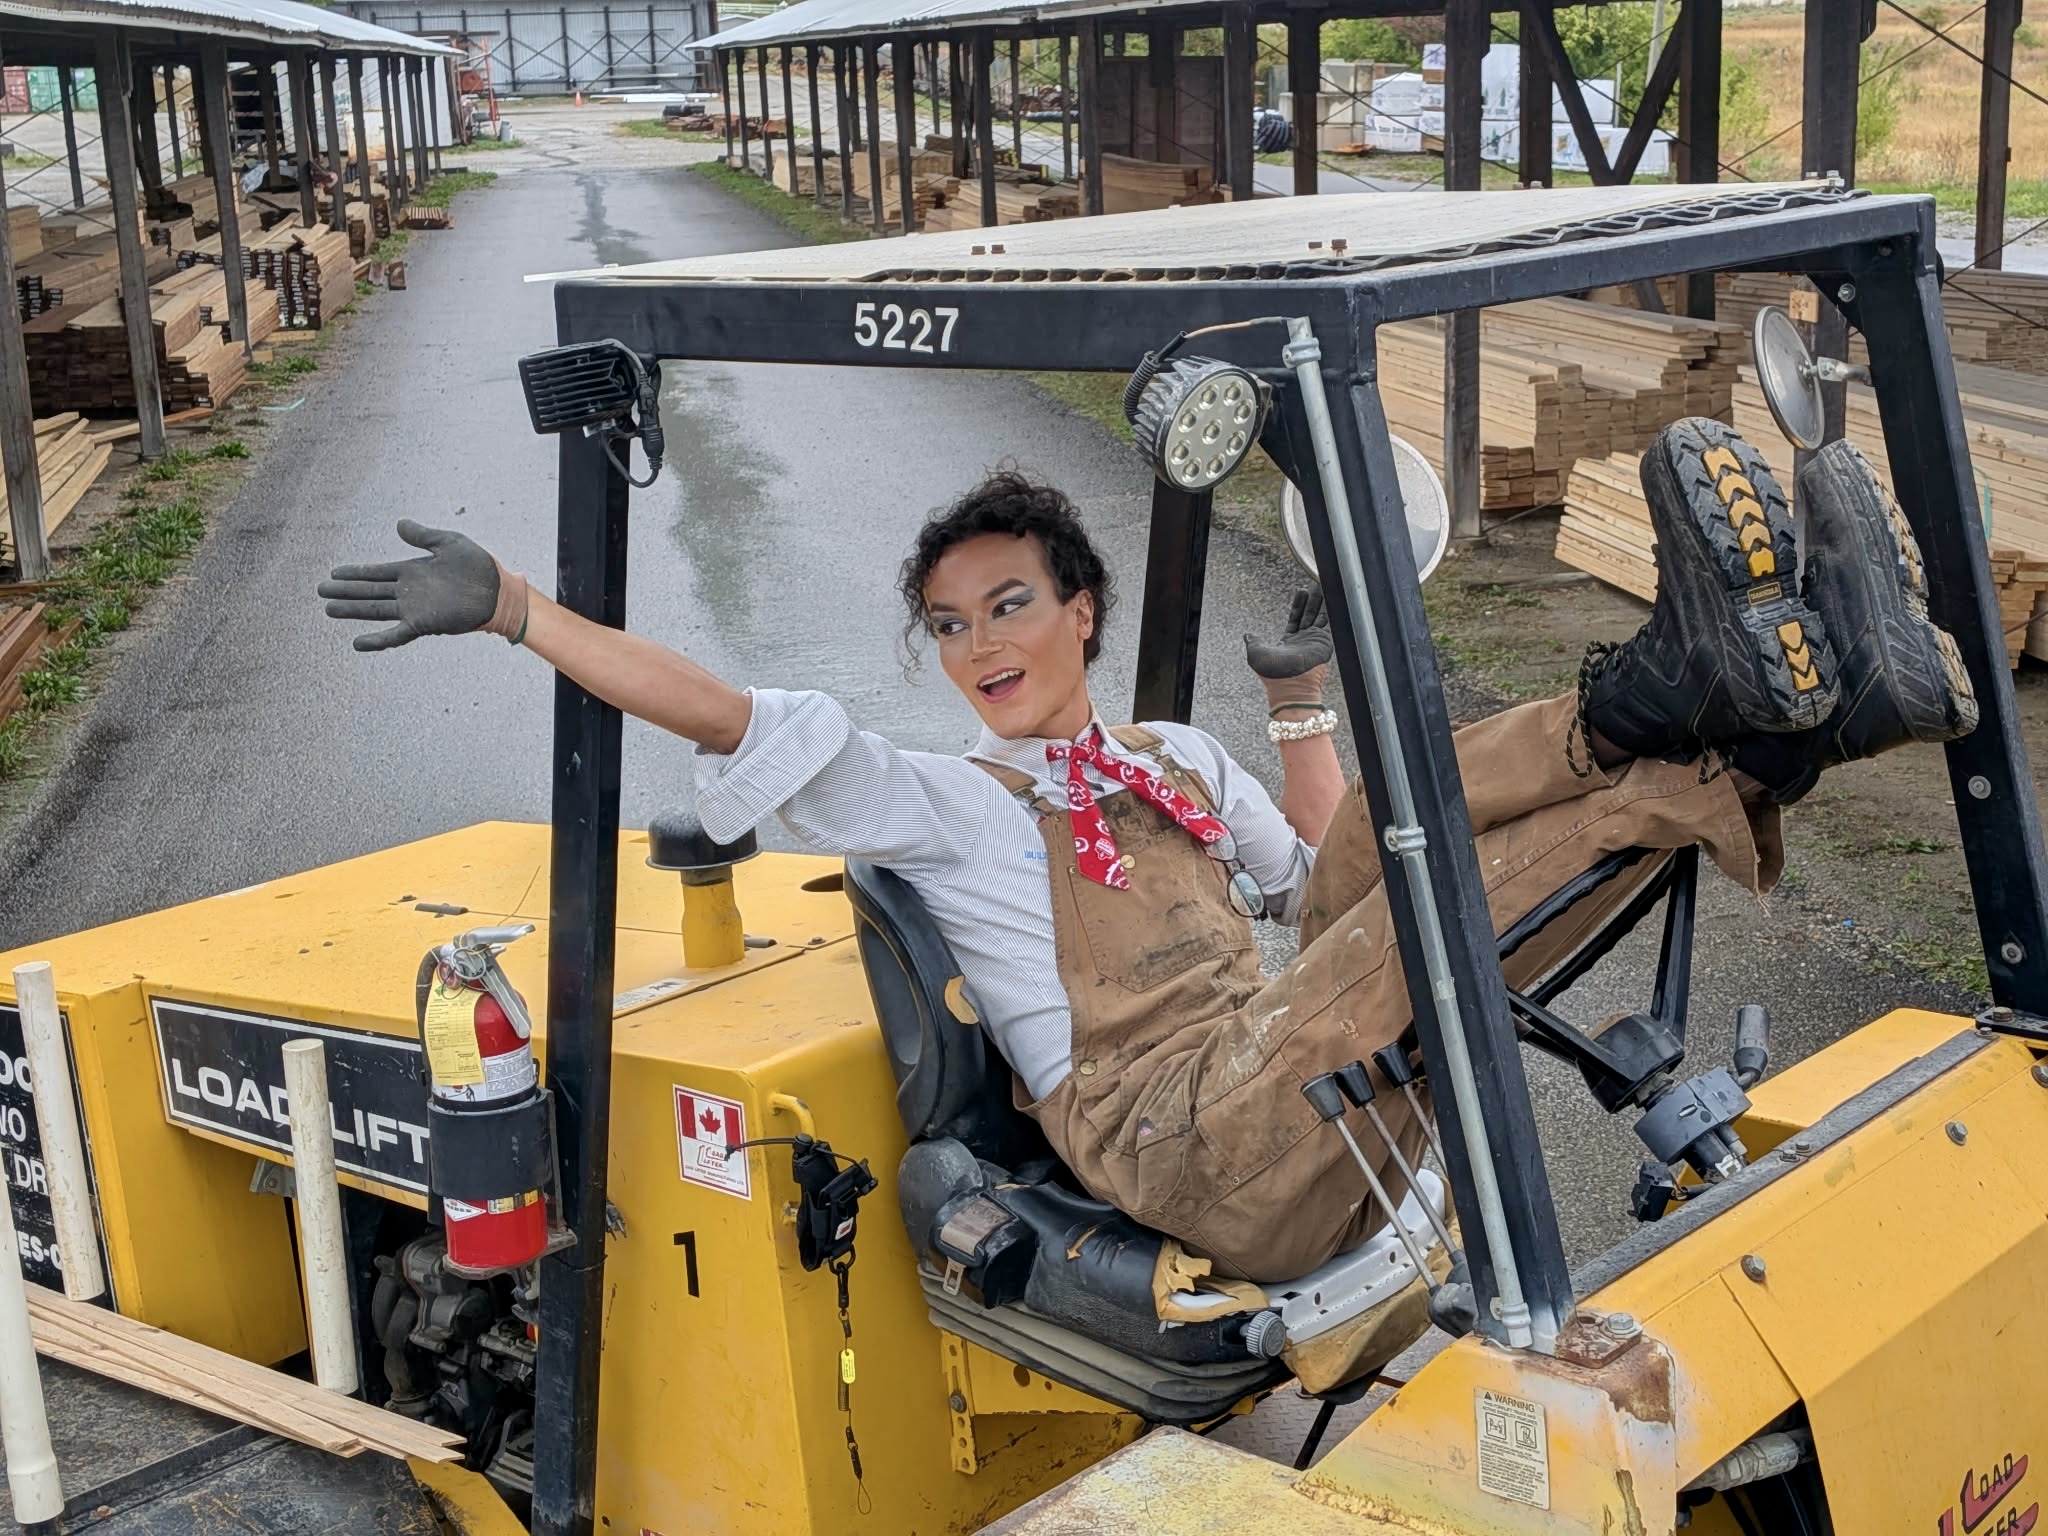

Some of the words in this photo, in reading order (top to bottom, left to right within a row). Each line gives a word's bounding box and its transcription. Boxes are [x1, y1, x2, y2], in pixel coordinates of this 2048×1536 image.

[854, 302, 959, 354] 5227
[673, 1230, 700, 1298] 1
[1494, 1393, 1535, 1413] WARNING
[1960, 1453, 2028, 1535] LOAD
